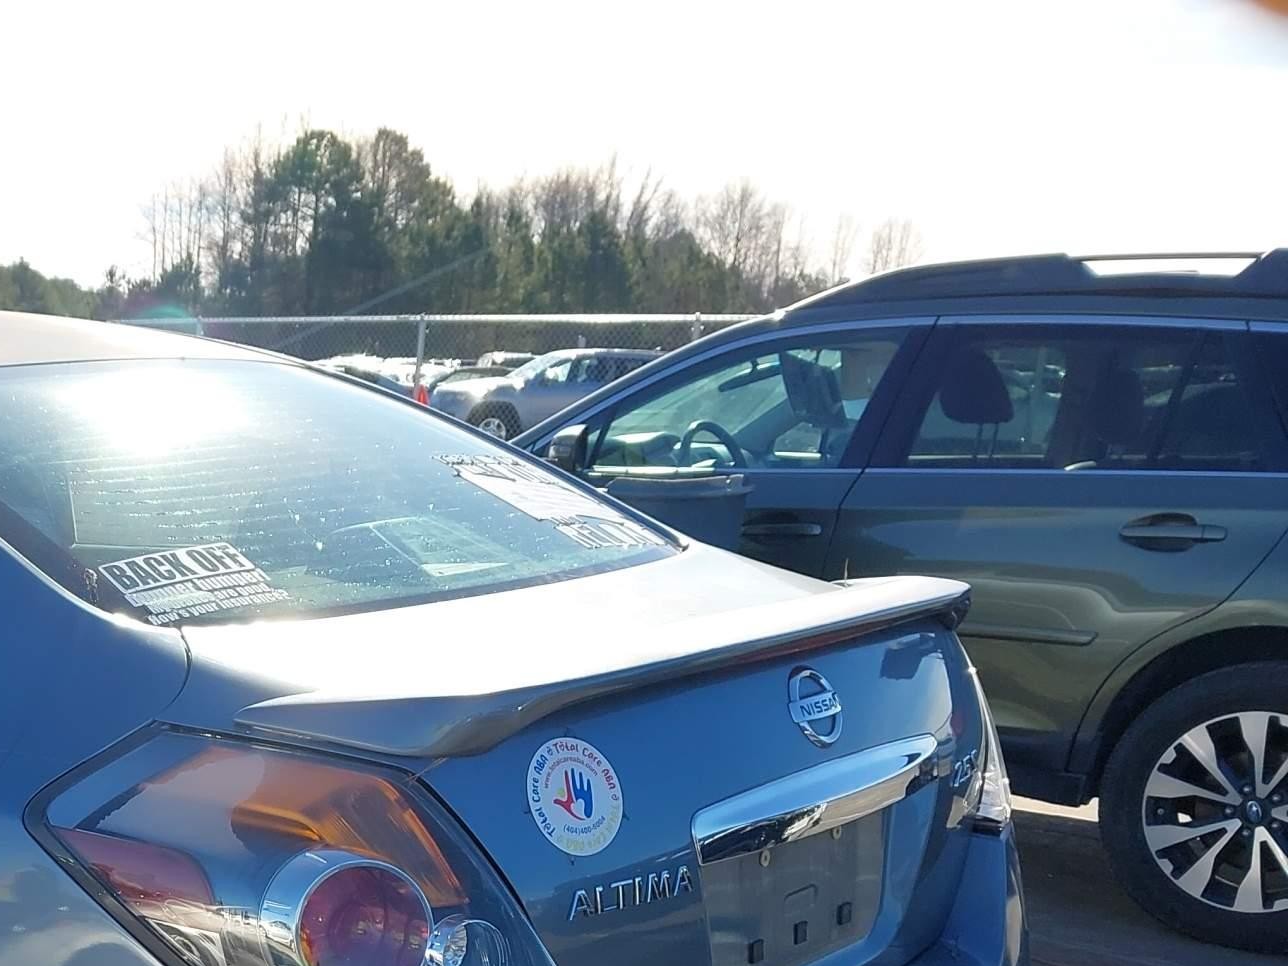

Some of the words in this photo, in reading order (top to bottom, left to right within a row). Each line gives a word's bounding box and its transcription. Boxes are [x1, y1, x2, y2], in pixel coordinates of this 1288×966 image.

[101, 552, 198, 590] BACK
[185, 544, 247, 573] OFF
[148, 608, 190, 625] How's
[186, 602, 219, 617] your
[534, 754, 549, 775] ABA
[582, 747, 602, 767] Care
[602, 768, 616, 790] ABA
[532, 777, 541, 803] Care
[570, 866, 692, 920] ALTIMA
